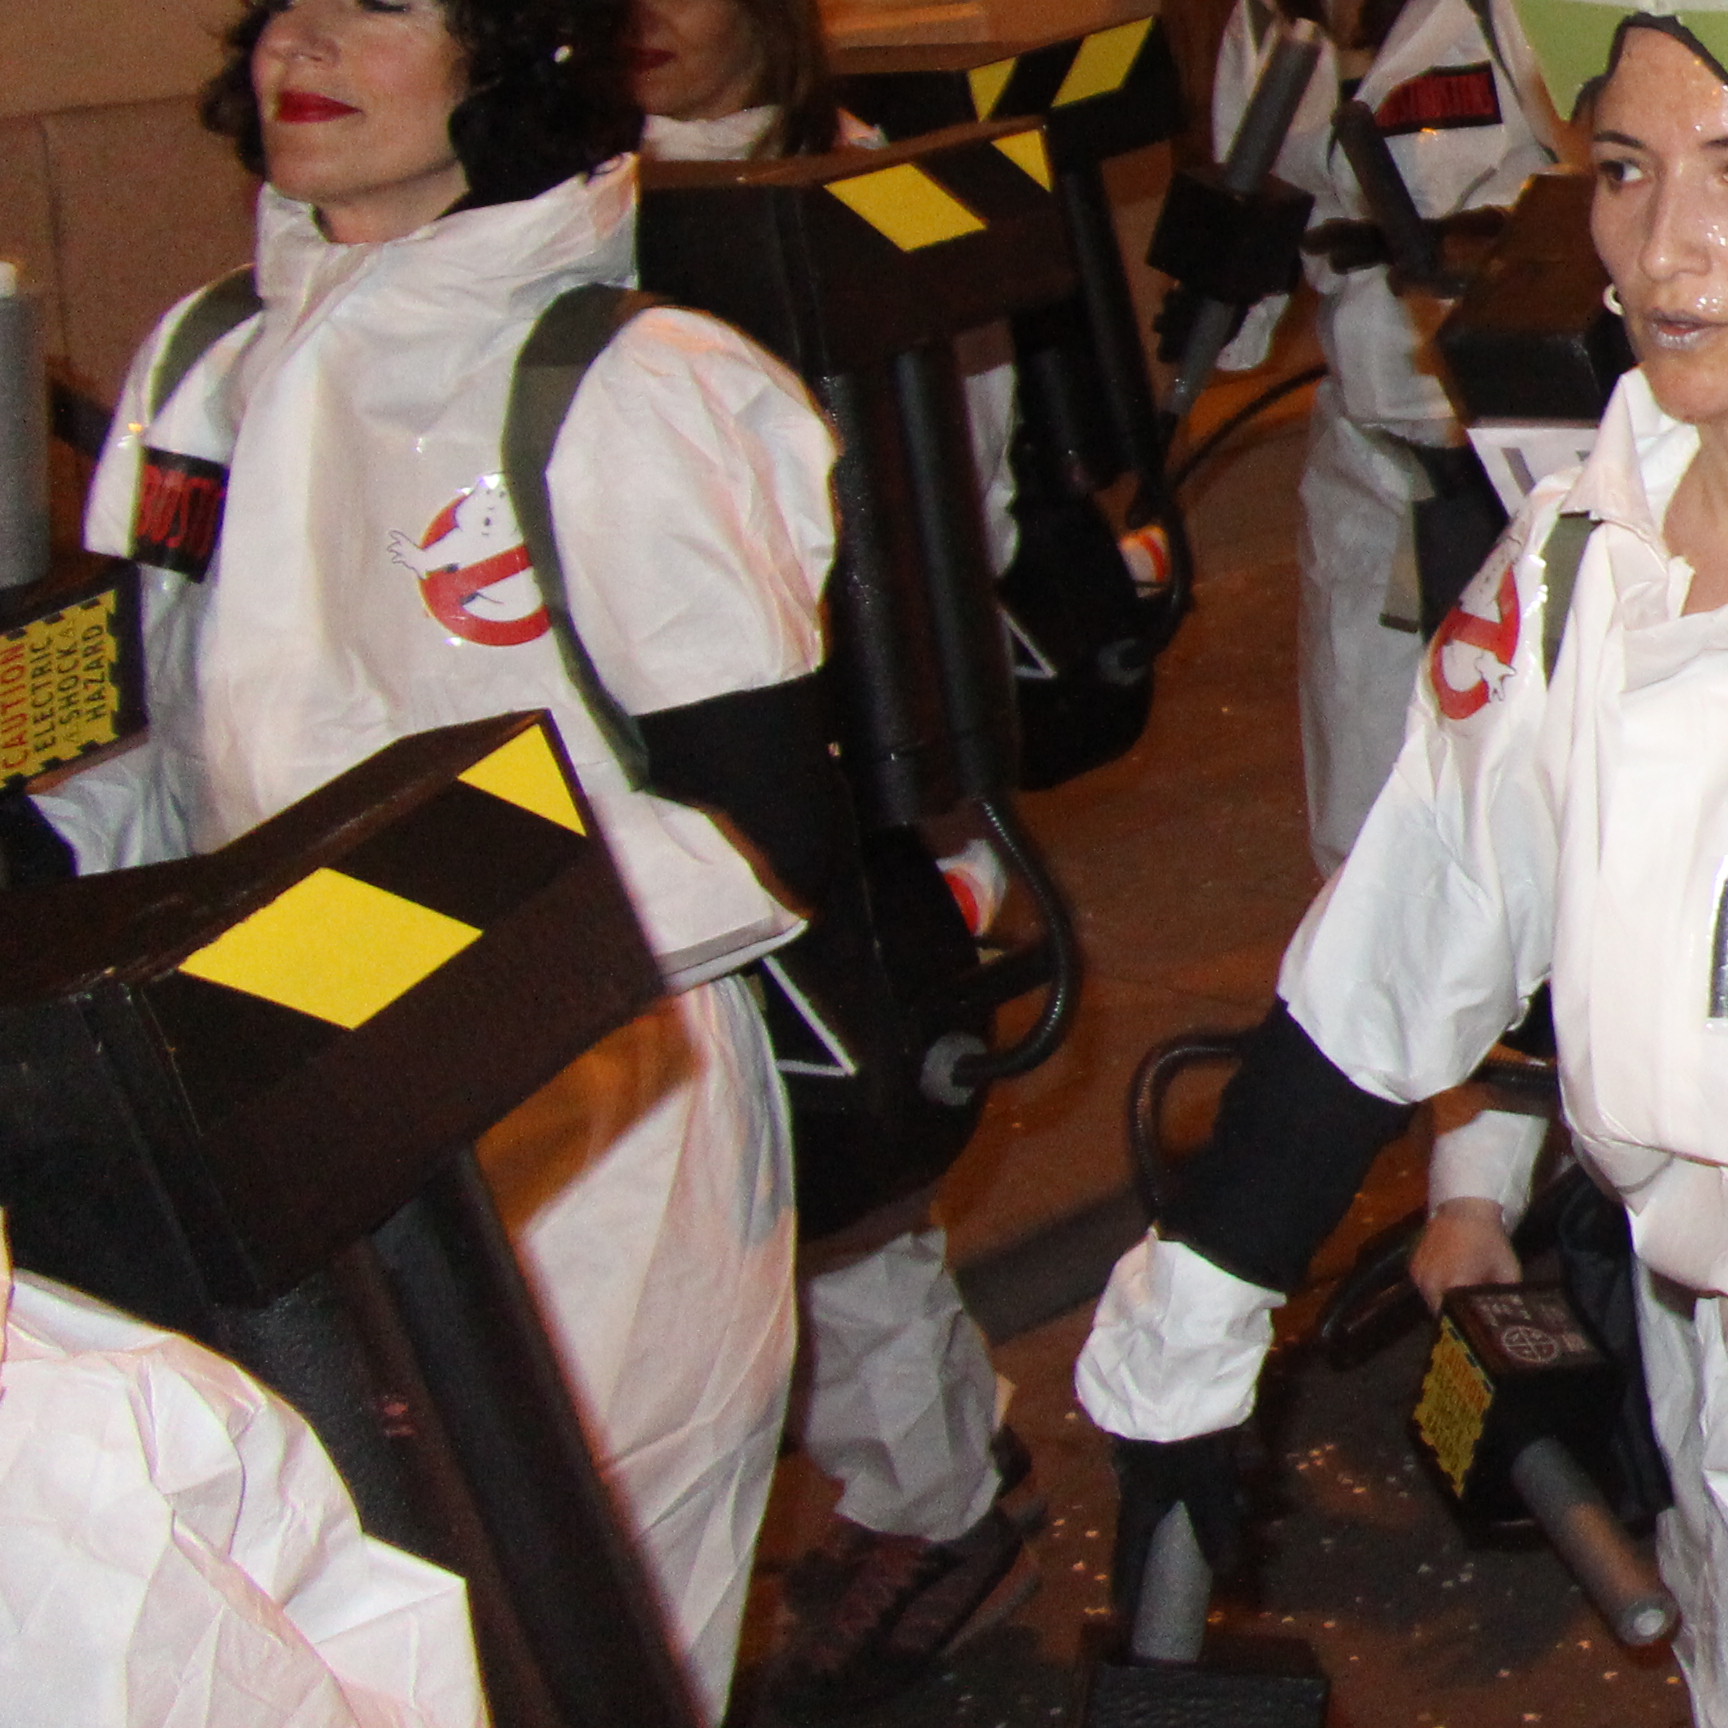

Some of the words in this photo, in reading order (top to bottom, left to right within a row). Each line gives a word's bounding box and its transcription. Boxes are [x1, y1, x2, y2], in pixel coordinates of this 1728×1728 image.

[0, 642, 29, 770] CAUTION
[29, 636, 57, 754] ELECTRIC
[55, 640, 82, 725] SHOCK
[80, 623, 107, 723] HAZARD
